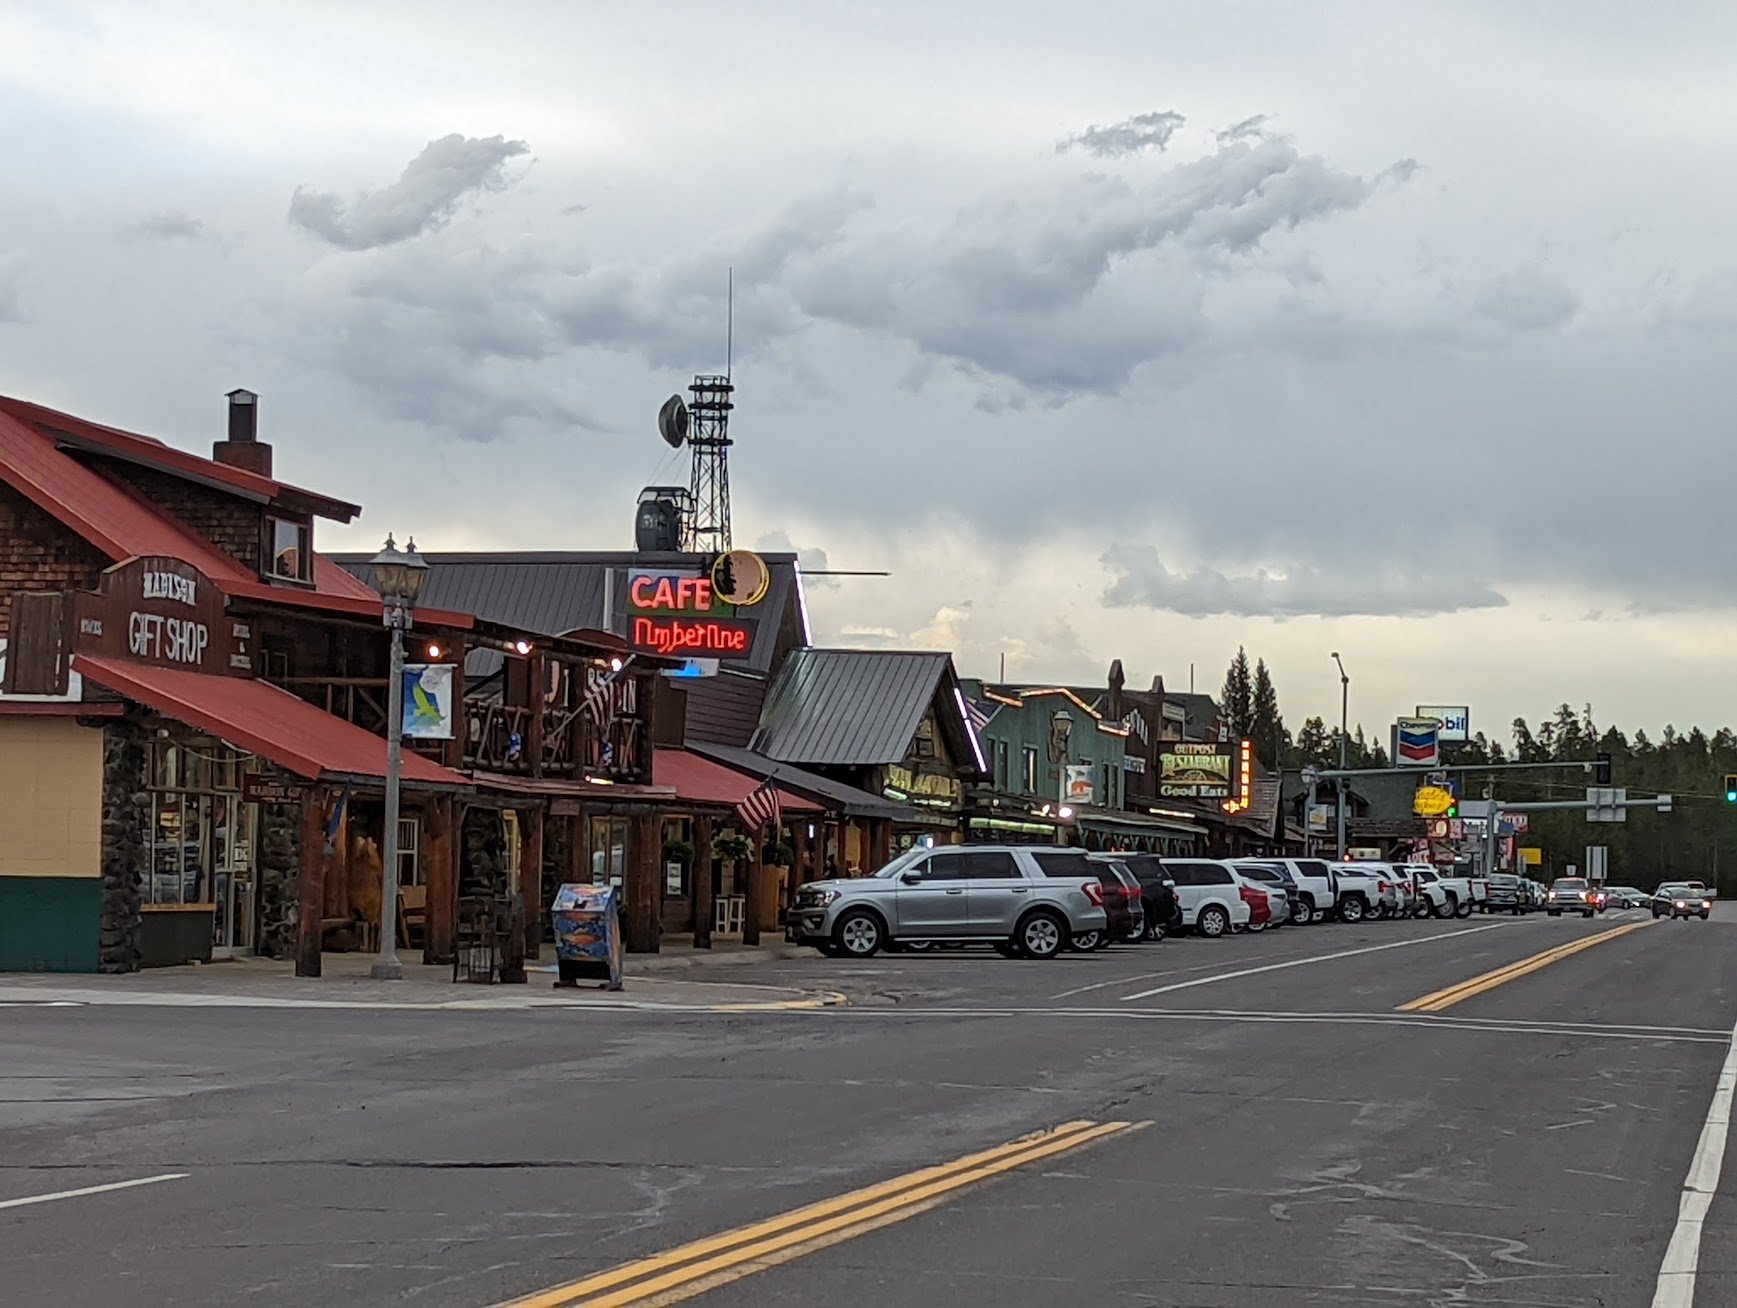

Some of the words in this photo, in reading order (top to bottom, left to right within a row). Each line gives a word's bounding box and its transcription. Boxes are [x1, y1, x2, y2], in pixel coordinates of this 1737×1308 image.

[631, 576, 711, 610] CAFE
[129, 611, 165, 658] GIFT
[165, 617, 209, 665] SHOP
[1438, 716, 1465, 731] obil
[1174, 743, 1217, 755] OUTPOST
[1160, 785, 1197, 797] Good
[1200, 785, 1228, 797] Eats
